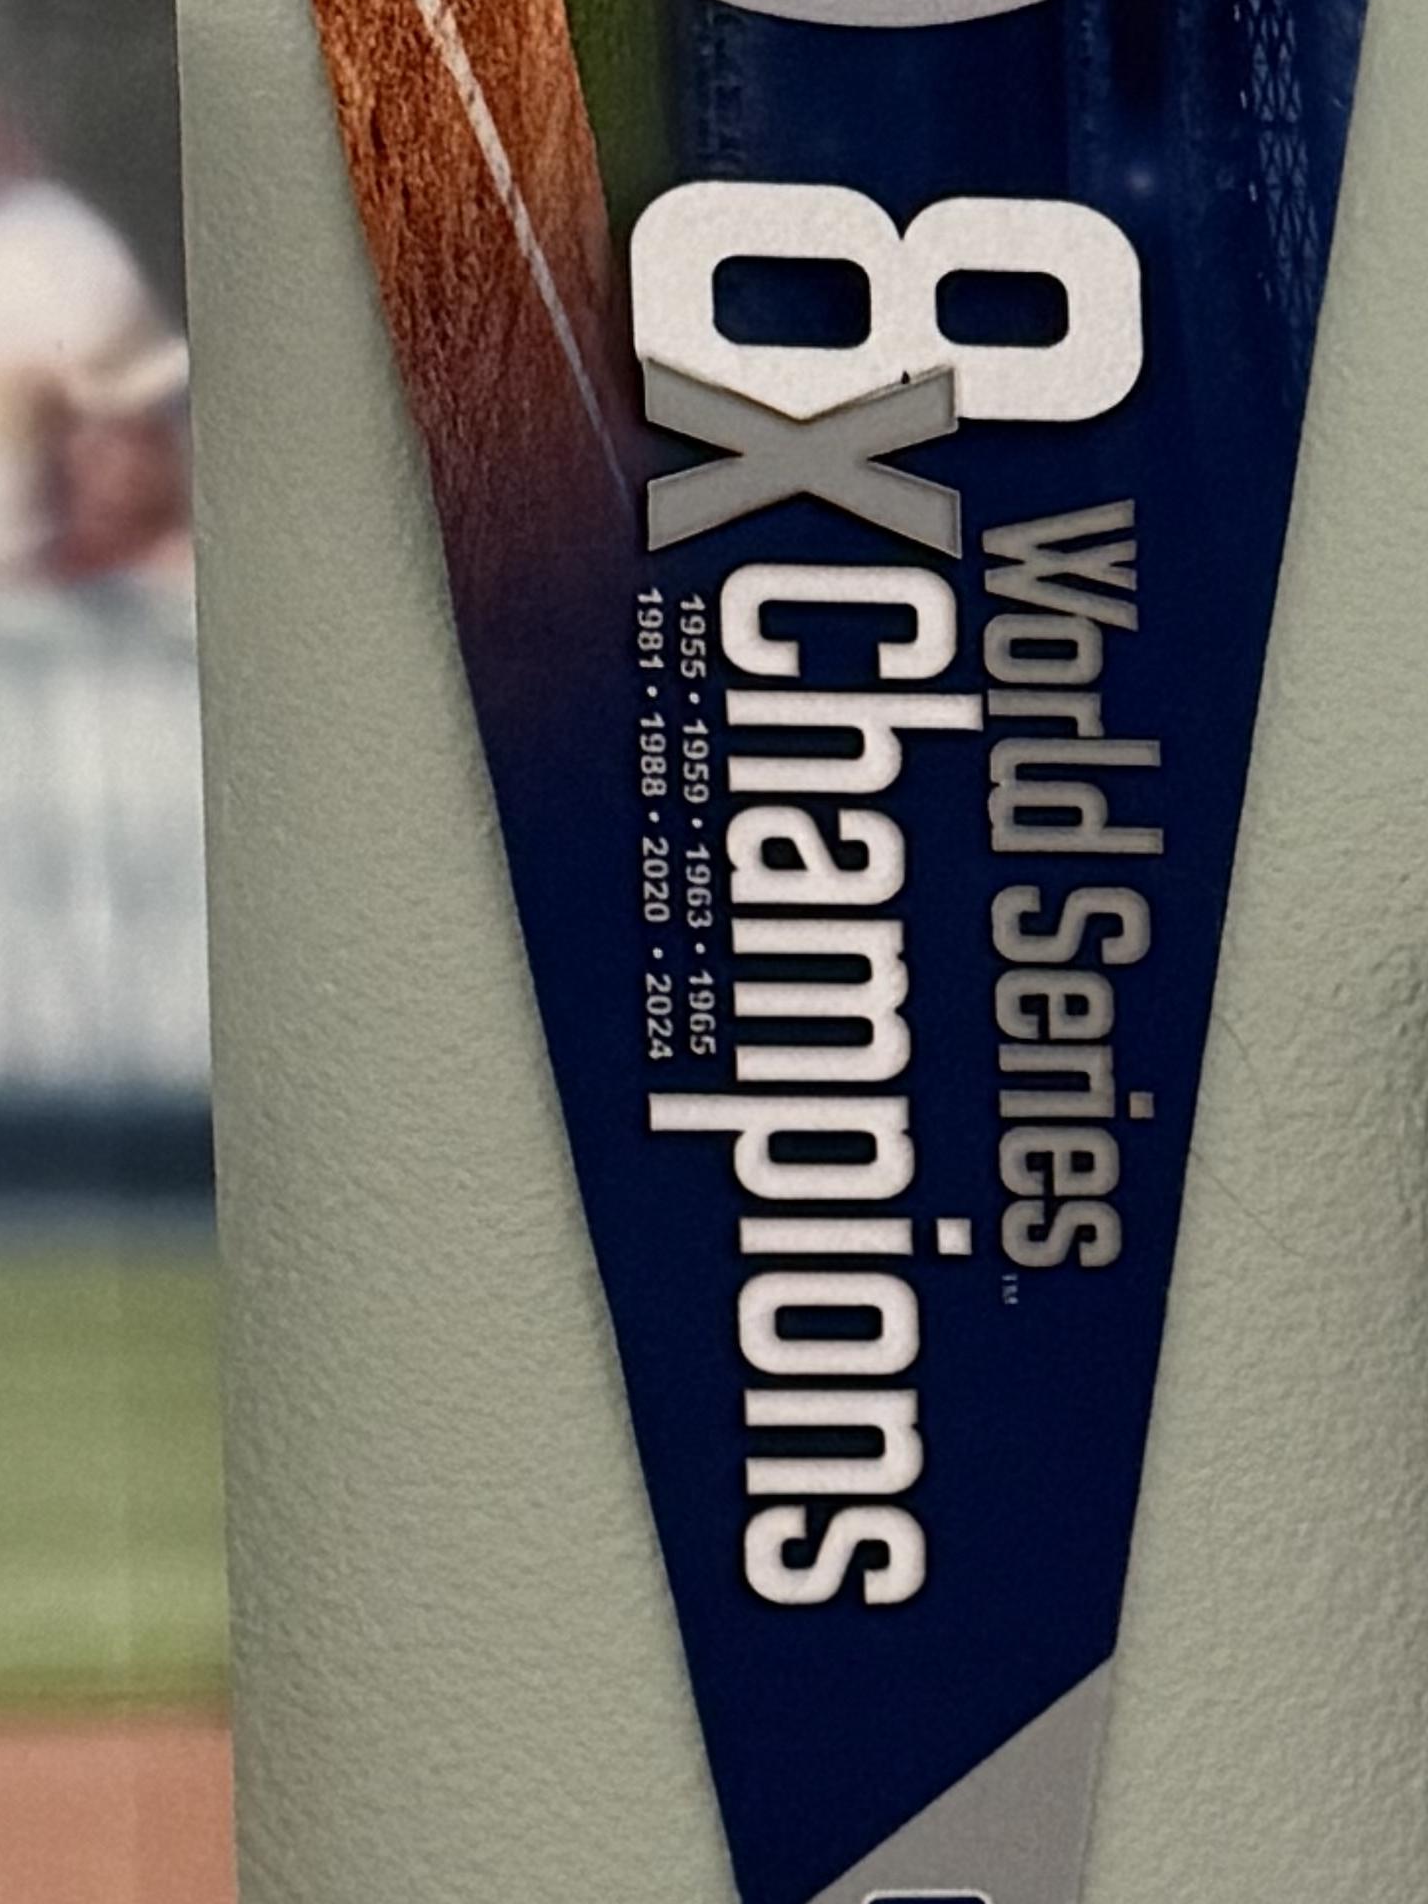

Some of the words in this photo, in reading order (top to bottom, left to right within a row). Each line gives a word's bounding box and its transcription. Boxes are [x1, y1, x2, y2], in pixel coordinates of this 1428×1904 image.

[636, 586, 665, 670] 1981
[679, 594, 707, 680] 1955
[981, 498, 1165, 855] World
[639, 712, 668, 798] 1988
[682, 718, 710, 805] 1959
[642, 837, 671, 924] 2020
[685, 842, 714, 930] 1963
[645, 973, 674, 1060] 2024
[688, 969, 717, 1056] 1965
[647, 562, 984, 1605] Champions
[990, 884, 1154, 1268] Series
